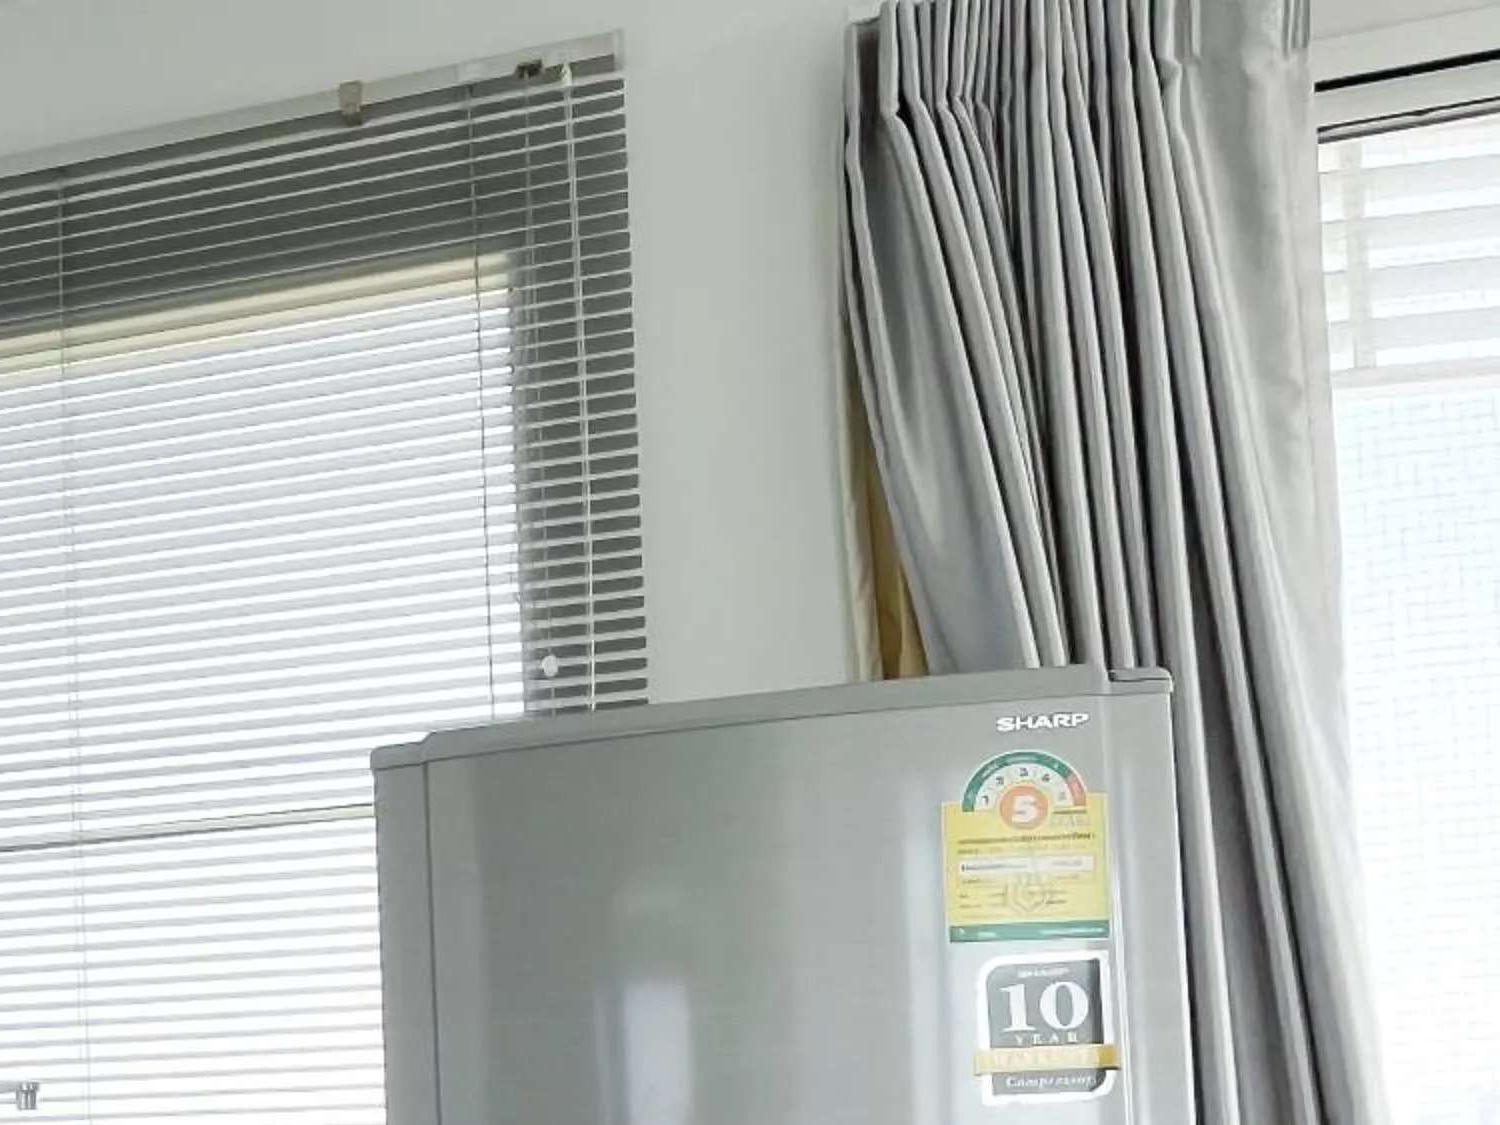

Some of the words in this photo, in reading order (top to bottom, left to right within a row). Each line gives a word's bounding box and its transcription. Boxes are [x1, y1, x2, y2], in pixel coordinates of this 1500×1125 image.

[996, 713, 1089, 732] SHARP
[1012, 795, 1038, 822] 5
[1000, 981, 1089, 1033] 10
